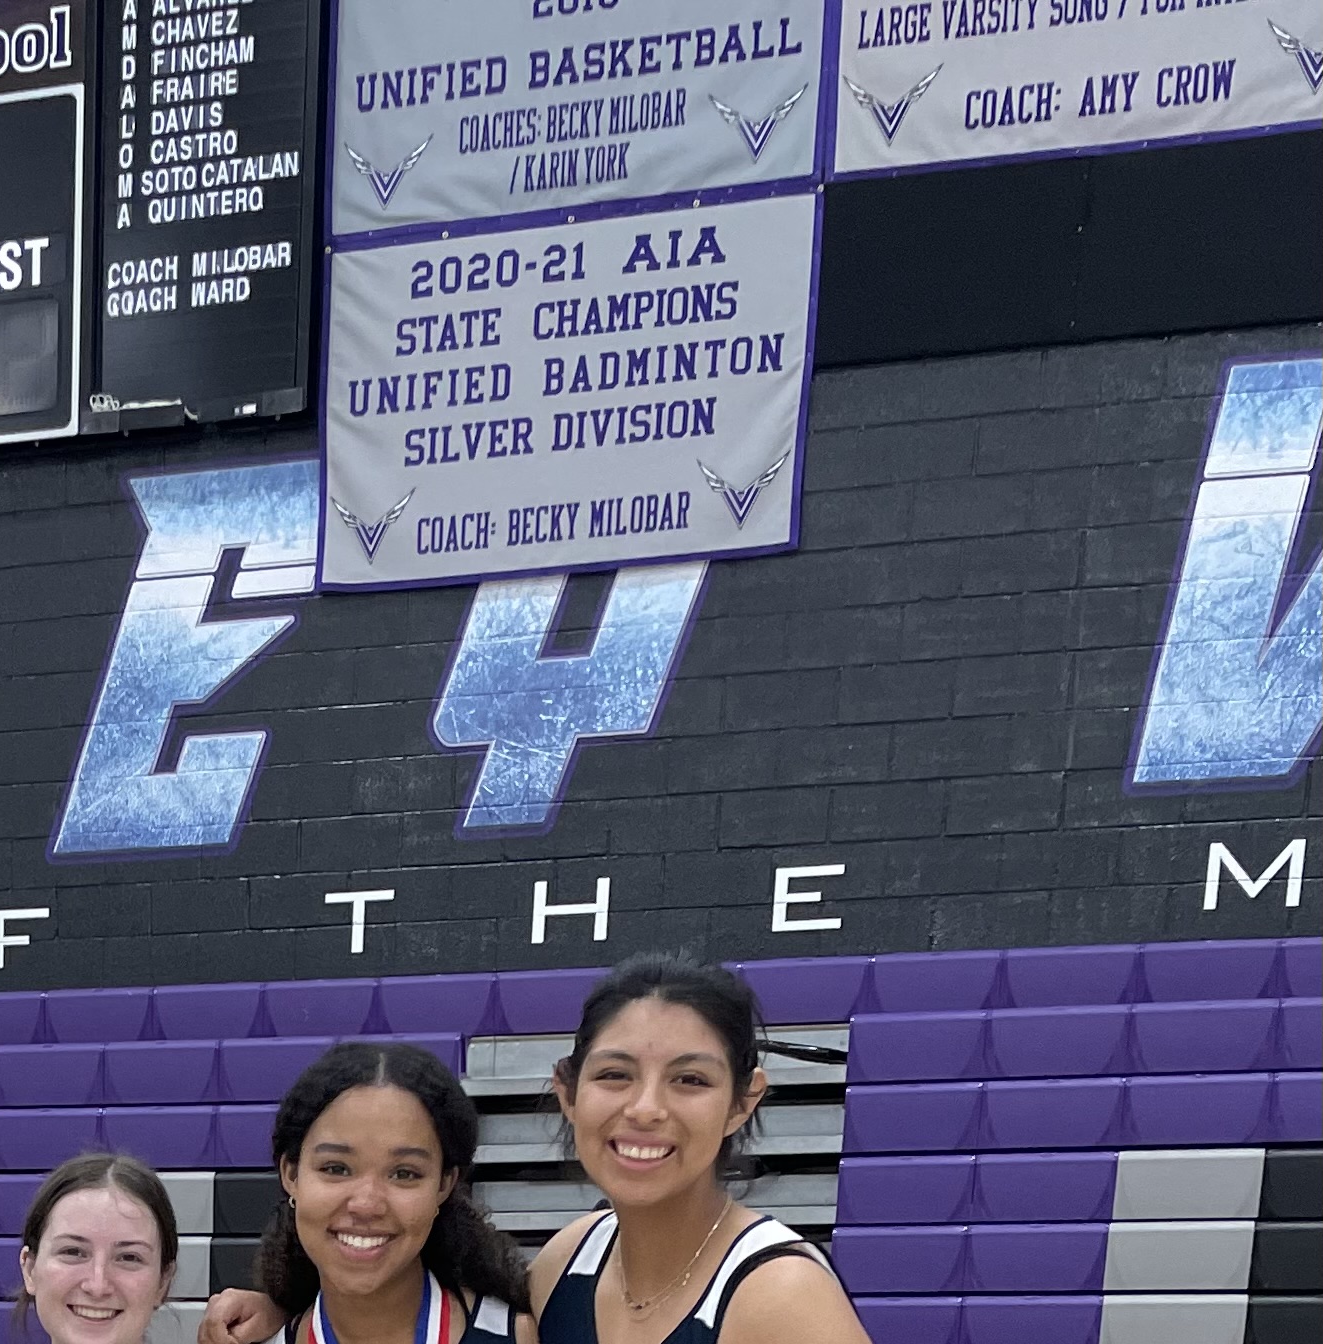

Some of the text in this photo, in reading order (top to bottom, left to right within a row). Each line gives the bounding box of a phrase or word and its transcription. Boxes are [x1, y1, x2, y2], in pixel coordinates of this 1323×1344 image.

[122, 23, 137, 51] M
[151, 8, 239, 46] CHAVEZ
[857, 4, 931, 50] LARGE
[941, 0, 1038, 41] VARSITY
[122, 35, 255, 81] D FINCHAM
[355, 17, 803, 114] UNIFIED BASKETBALL
[120, 68, 238, 110] A FRAIRE
[964, 59, 1237, 131] COACH: AMY CROW
[121, 101, 224, 139] L DAVIS
[459, 87, 687, 155] COACHES: BECKY MILOBAR
[118, 151, 300, 198] M SOTO CATALAN
[119, 130, 238, 169] O CASTRO
[509, 142, 631, 196] / KARIN YORK
[117, 186, 264, 229] A QUINTERO
[108, 242, 292, 290] COACH MILOBAR
[410, 225, 726, 299] 2020-21 AIA
[191, 276, 251, 307] WARD
[396, 281, 740, 357] STATE CHAMPIONS
[348, 333, 785, 417] UNIFIED BADMINTON
[404, 397, 717, 467] SILVER DIVISION
[417, 491, 691, 555] COACH: BECKY MILOBAR
[323, 862, 848, 954] THE
